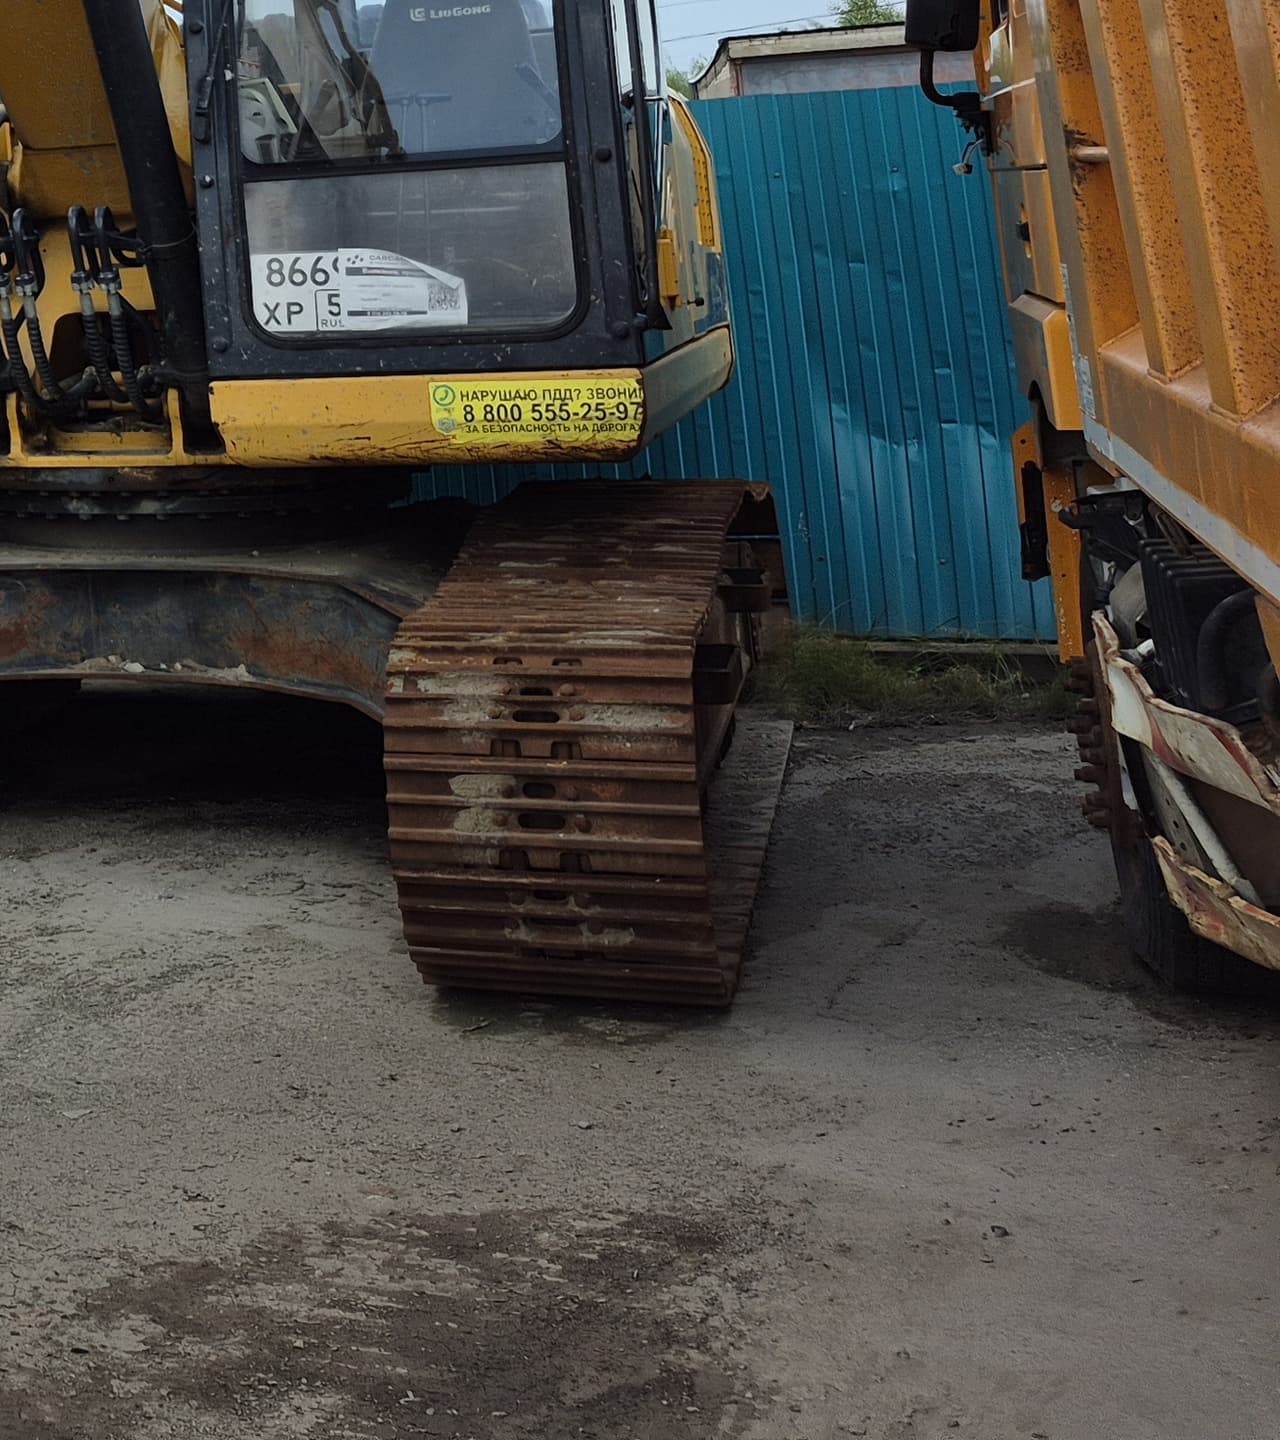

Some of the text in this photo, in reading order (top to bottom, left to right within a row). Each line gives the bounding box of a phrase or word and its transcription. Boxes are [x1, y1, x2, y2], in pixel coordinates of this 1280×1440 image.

[327, 293, 341, 317] 5
[460, 389, 538, 402] НАРУШАЮ
[542, 388, 582, 402] ПДД?
[463, 401, 643, 423] 8 800 555-25-97
[465, 424, 480, 434] ЗА
[482, 423, 571, 433] БЕЗОПАСНОСТЬ
[573, 423, 589, 433] НА
